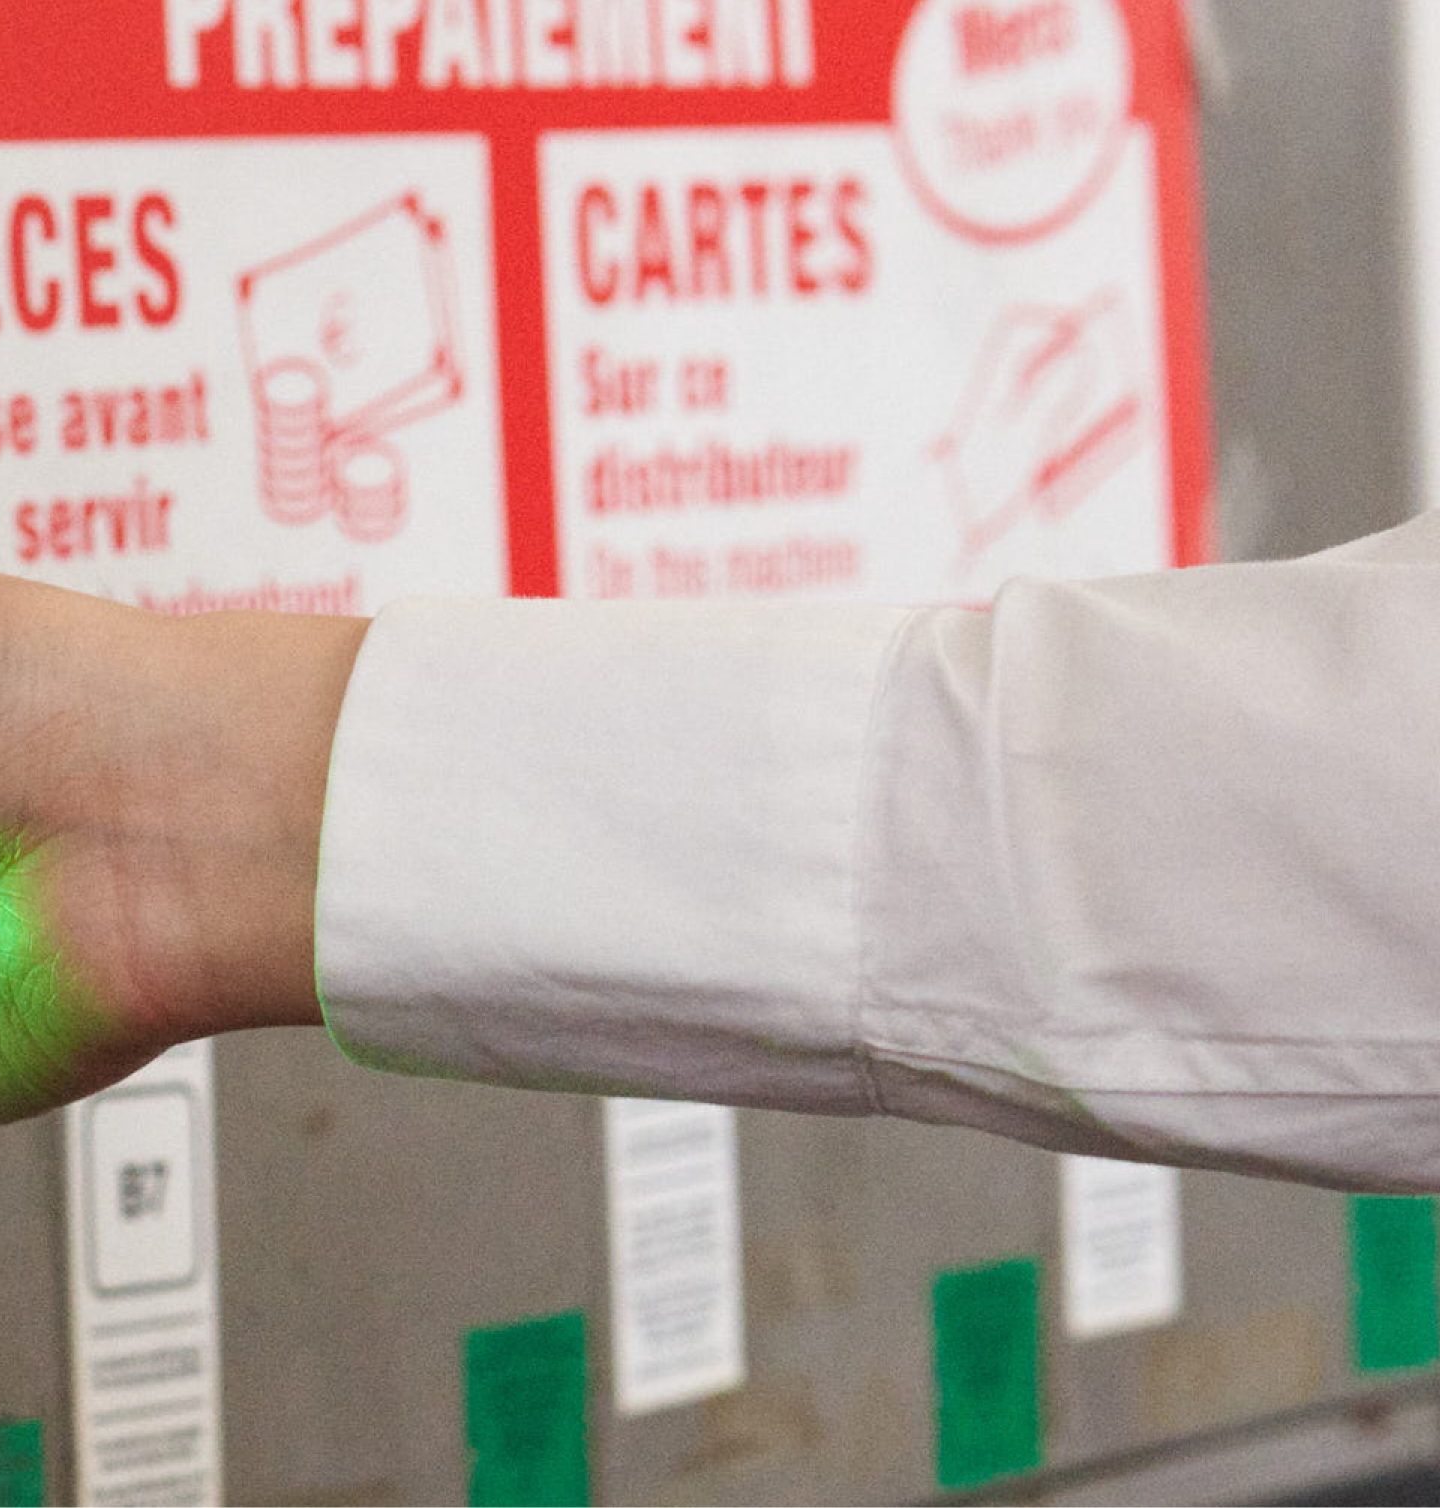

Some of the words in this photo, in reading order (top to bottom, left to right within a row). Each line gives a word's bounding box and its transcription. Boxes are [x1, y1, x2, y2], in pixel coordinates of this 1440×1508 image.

[575, 177, 872, 306] CARTES
[59, 368, 210, 452] avant
[580, 344, 658, 417] Sur
[16, 475, 173, 566] servir
